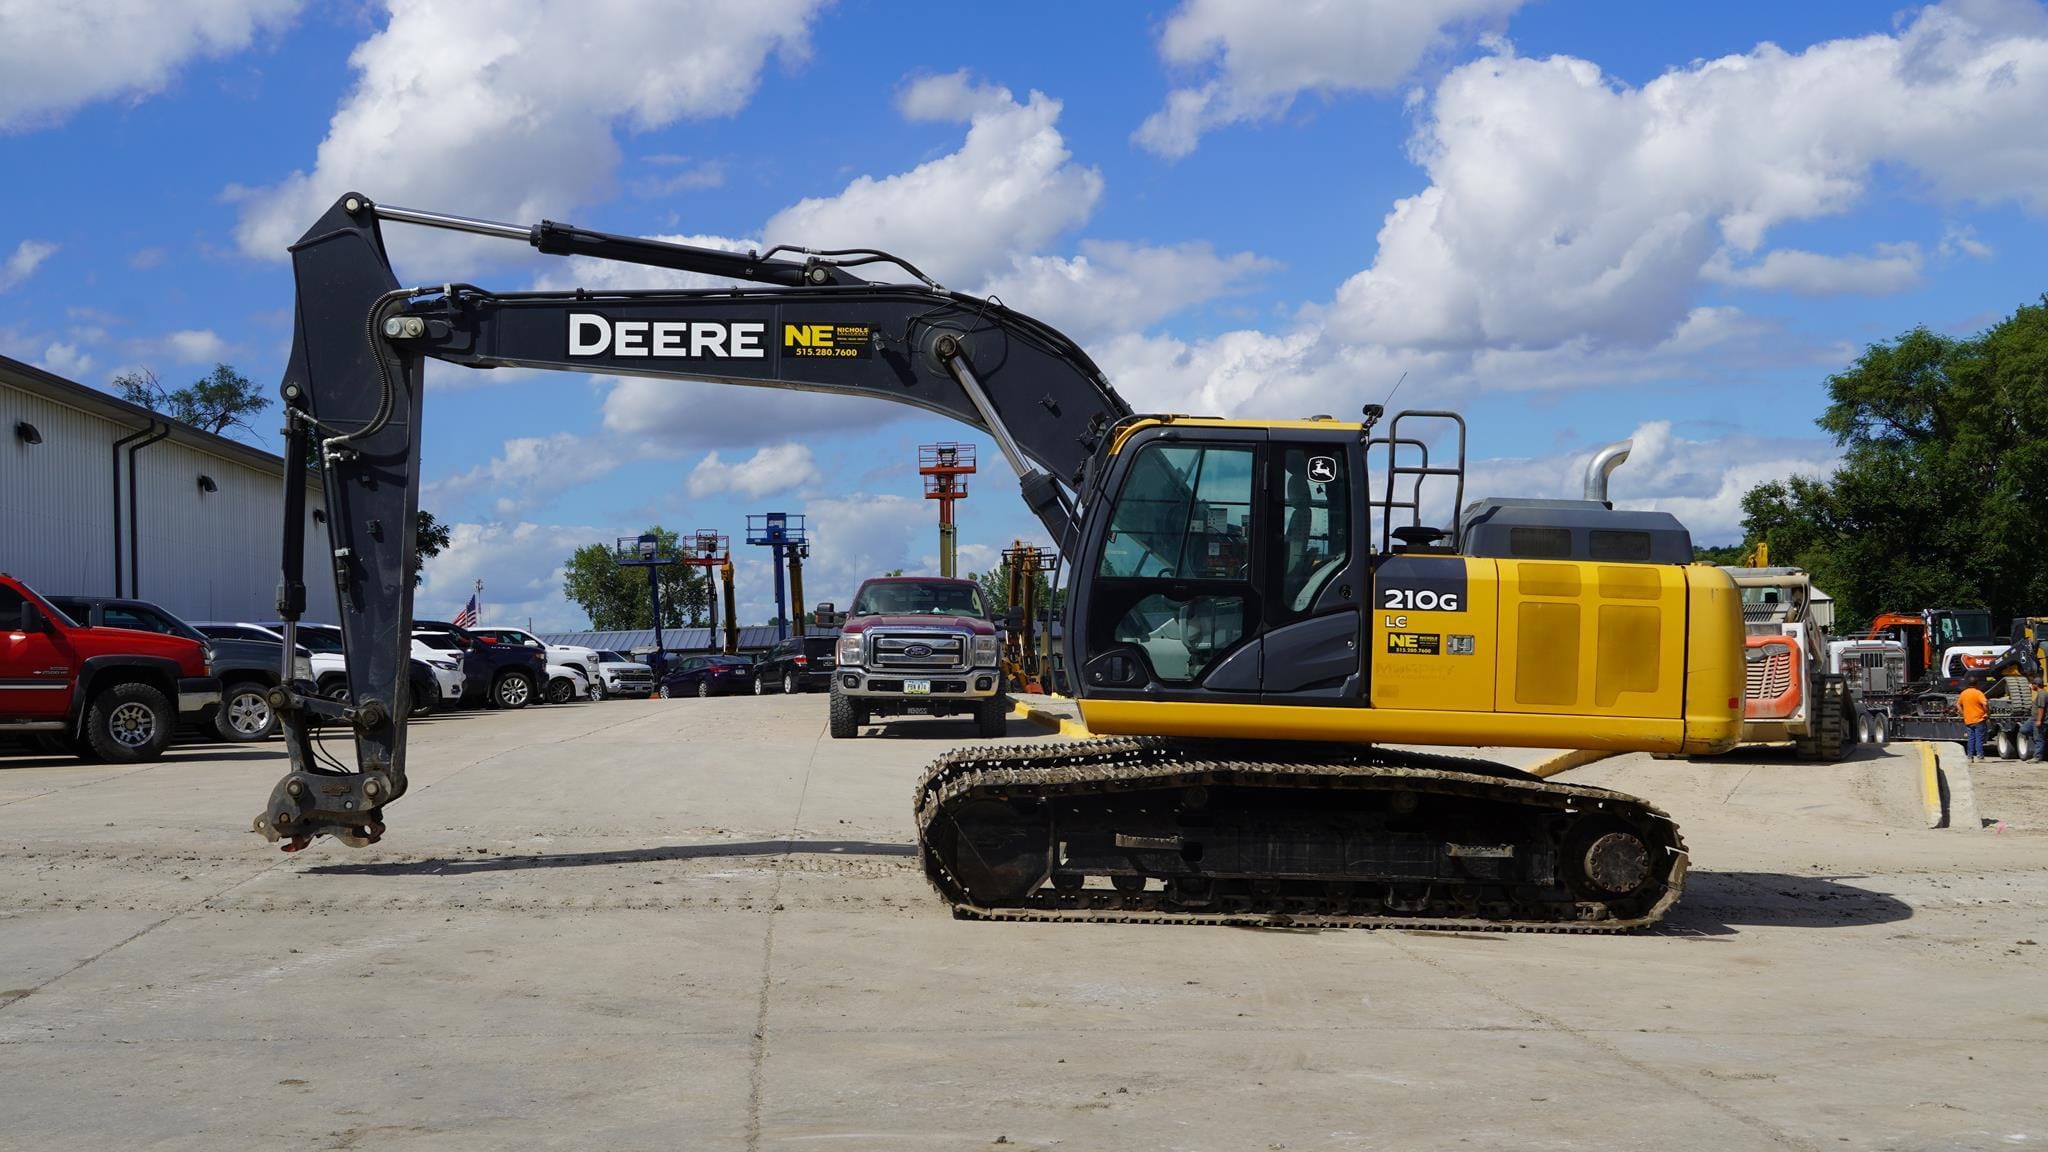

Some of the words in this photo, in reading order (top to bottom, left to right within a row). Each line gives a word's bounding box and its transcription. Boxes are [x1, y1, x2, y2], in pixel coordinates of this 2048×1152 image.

[569, 313, 765, 358] DEERE
[785, 324, 834, 347] NE
[795, 347, 858, 357] 515.280.7600
[1384, 589, 1458, 611] 210G
[1385, 615, 1407, 628] LC
[1389, 634, 1418, 647] NE
